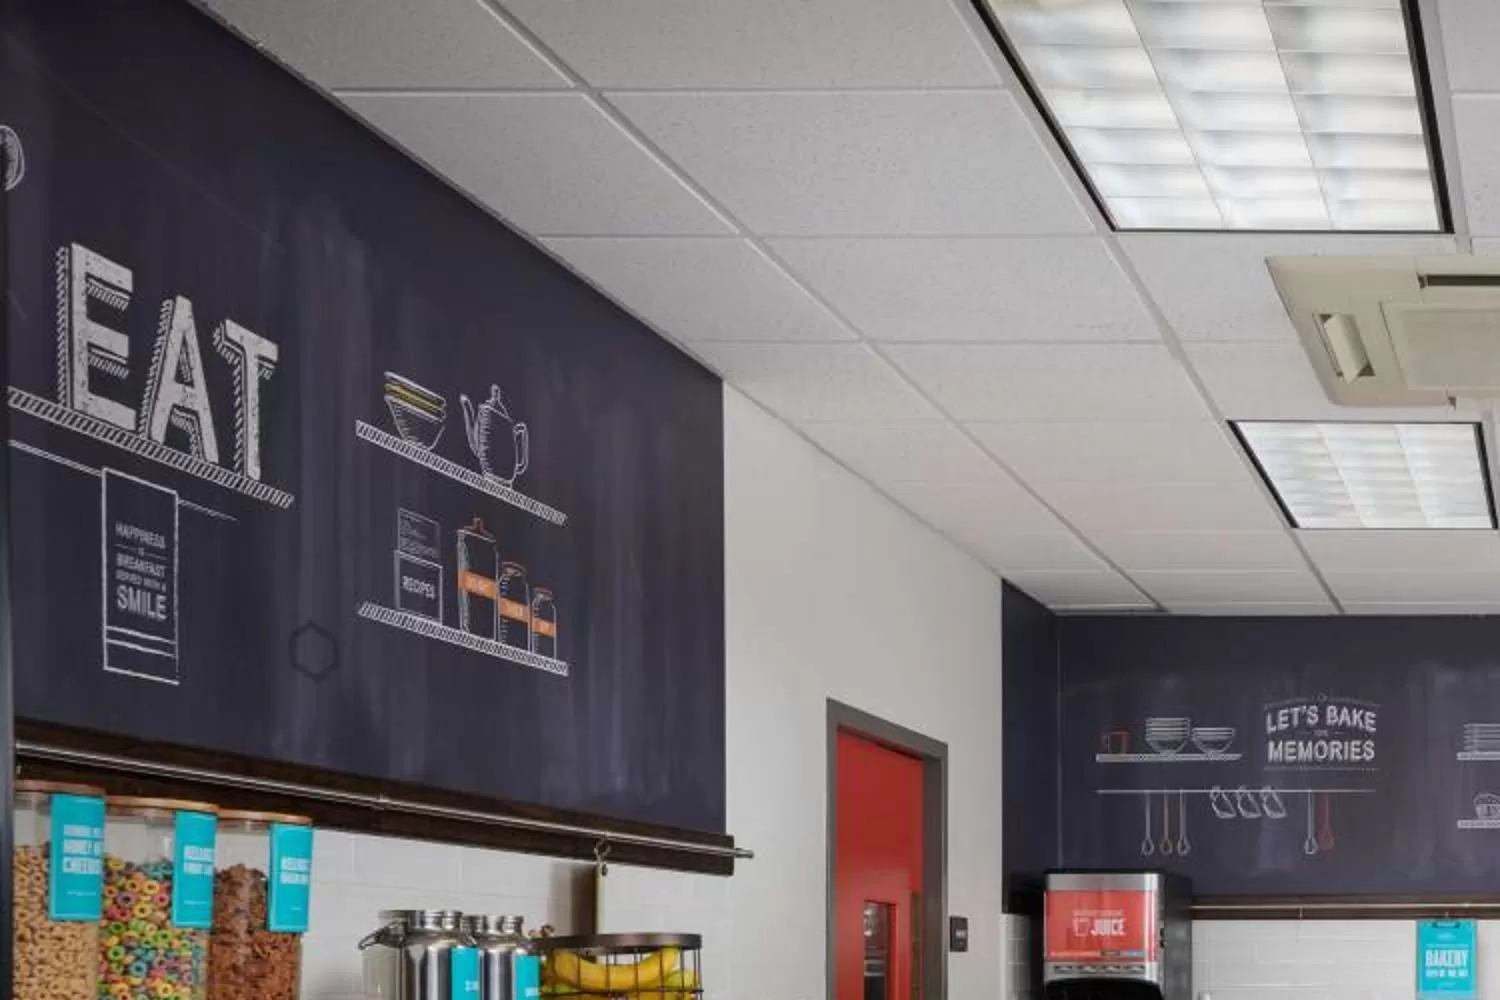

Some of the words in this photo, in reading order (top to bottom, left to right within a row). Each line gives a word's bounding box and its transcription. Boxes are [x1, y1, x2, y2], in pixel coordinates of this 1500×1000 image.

[56, 241, 279, 481] EAT
[117, 584, 167, 621] SMILE
[1266, 704, 1319, 734] LET'S
[1326, 704, 1377, 732] BAKE
[1267, 739, 1376, 763] MEMORIES
[1090, 918, 1126, 937] JUICE
[1425, 949, 1469, 966] BAKERY
